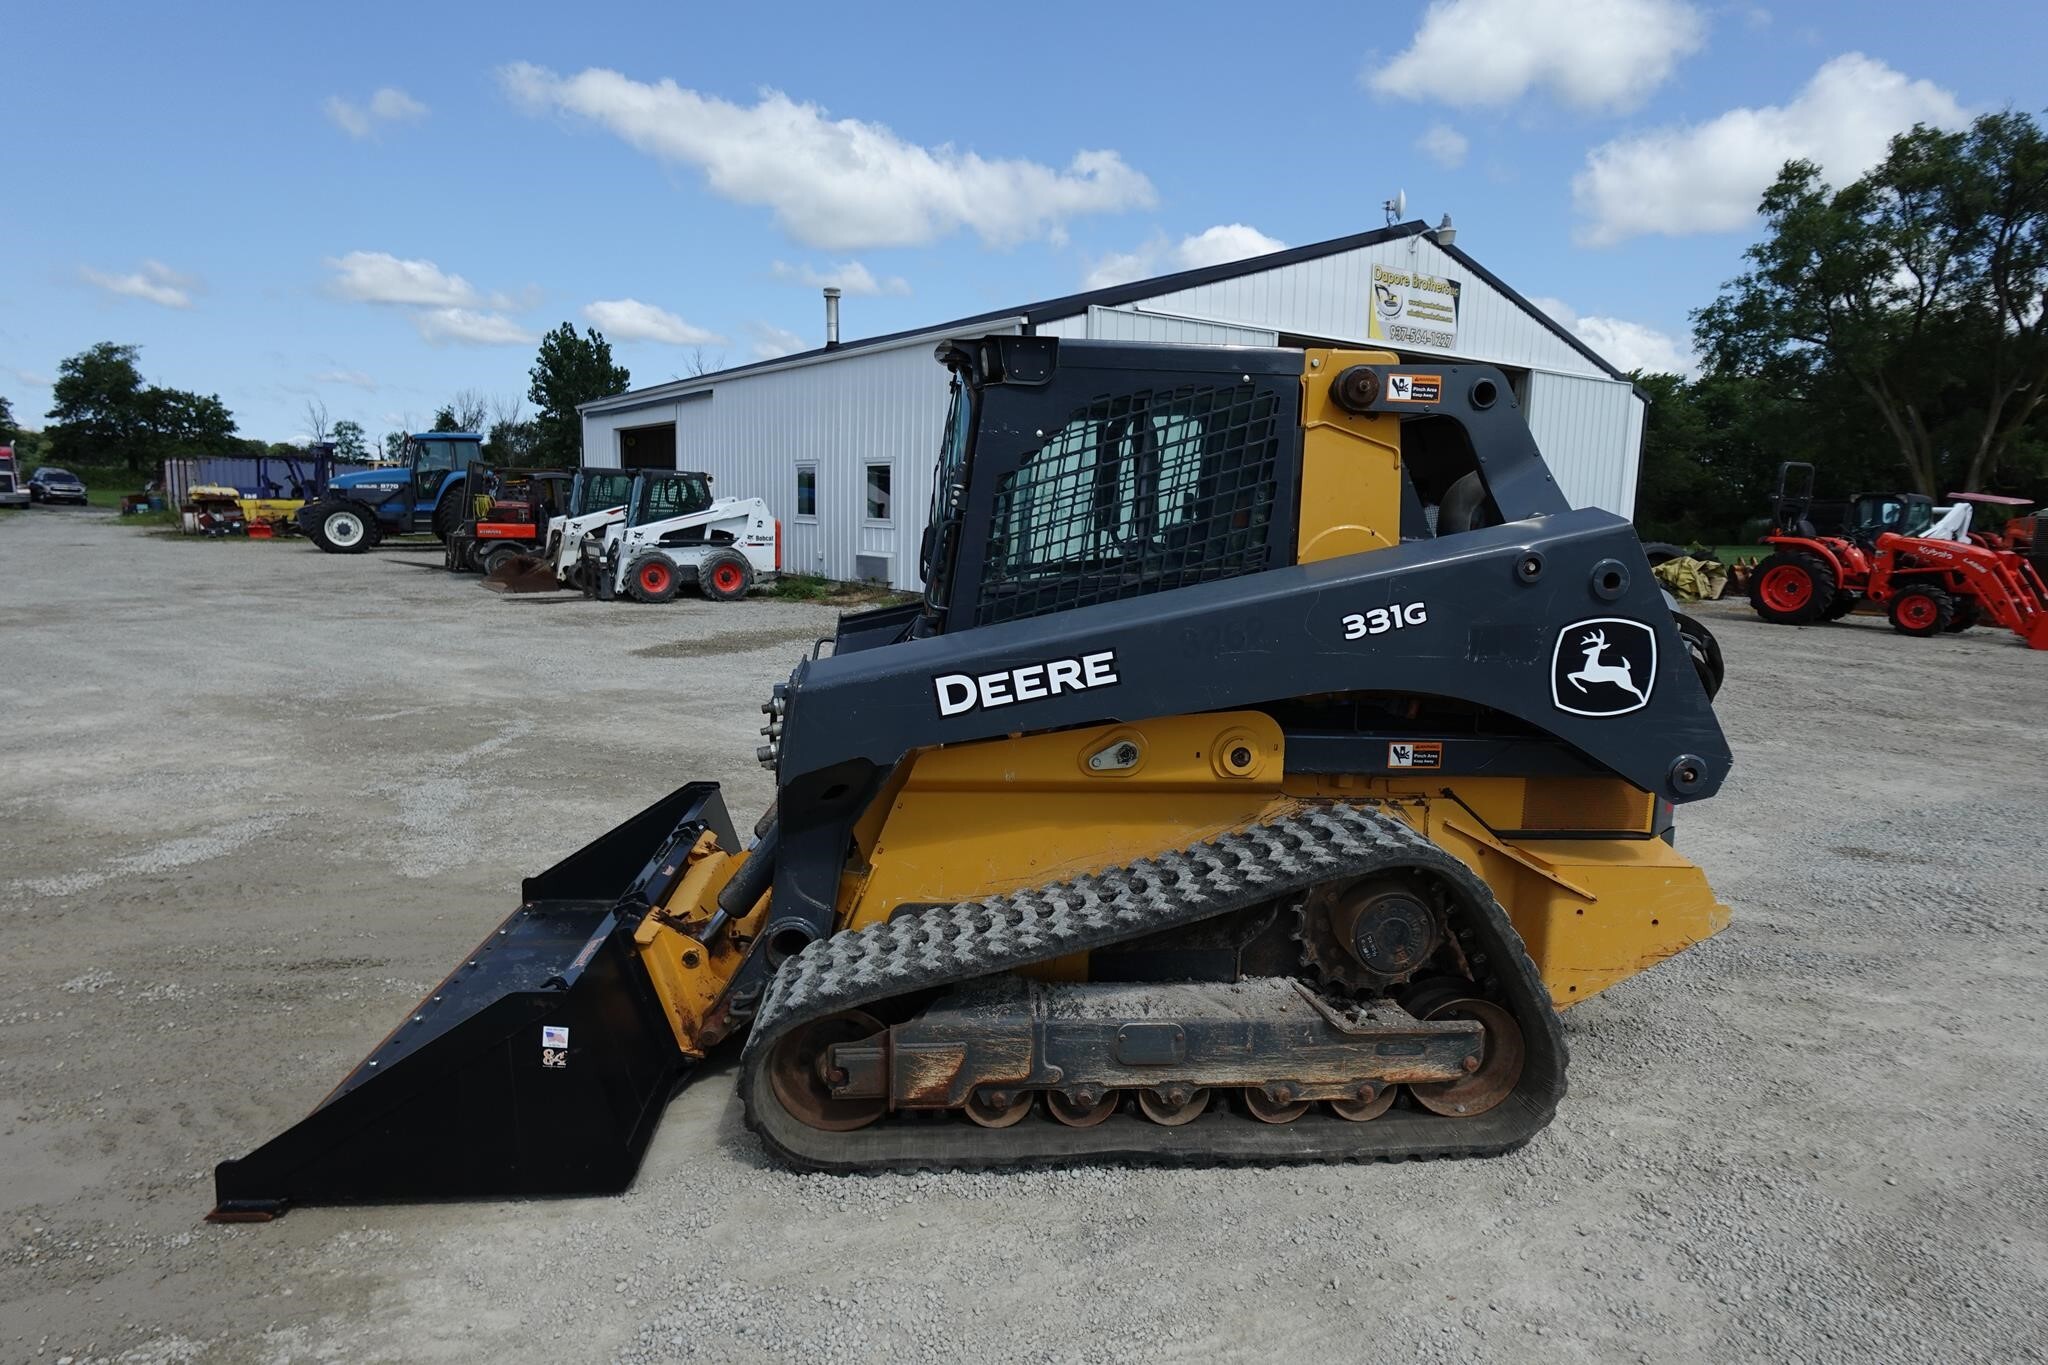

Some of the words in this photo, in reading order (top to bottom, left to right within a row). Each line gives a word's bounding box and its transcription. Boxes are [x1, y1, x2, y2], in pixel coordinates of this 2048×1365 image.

[1374, 265, 1410, 287] Dapore
[1412, 272, 1450, 295] Brothers
[1389, 325, 1453, 348] 937-564-1227
[1342, 602, 1427, 640] 331G
[935, 651, 1118, 716] DEERE
